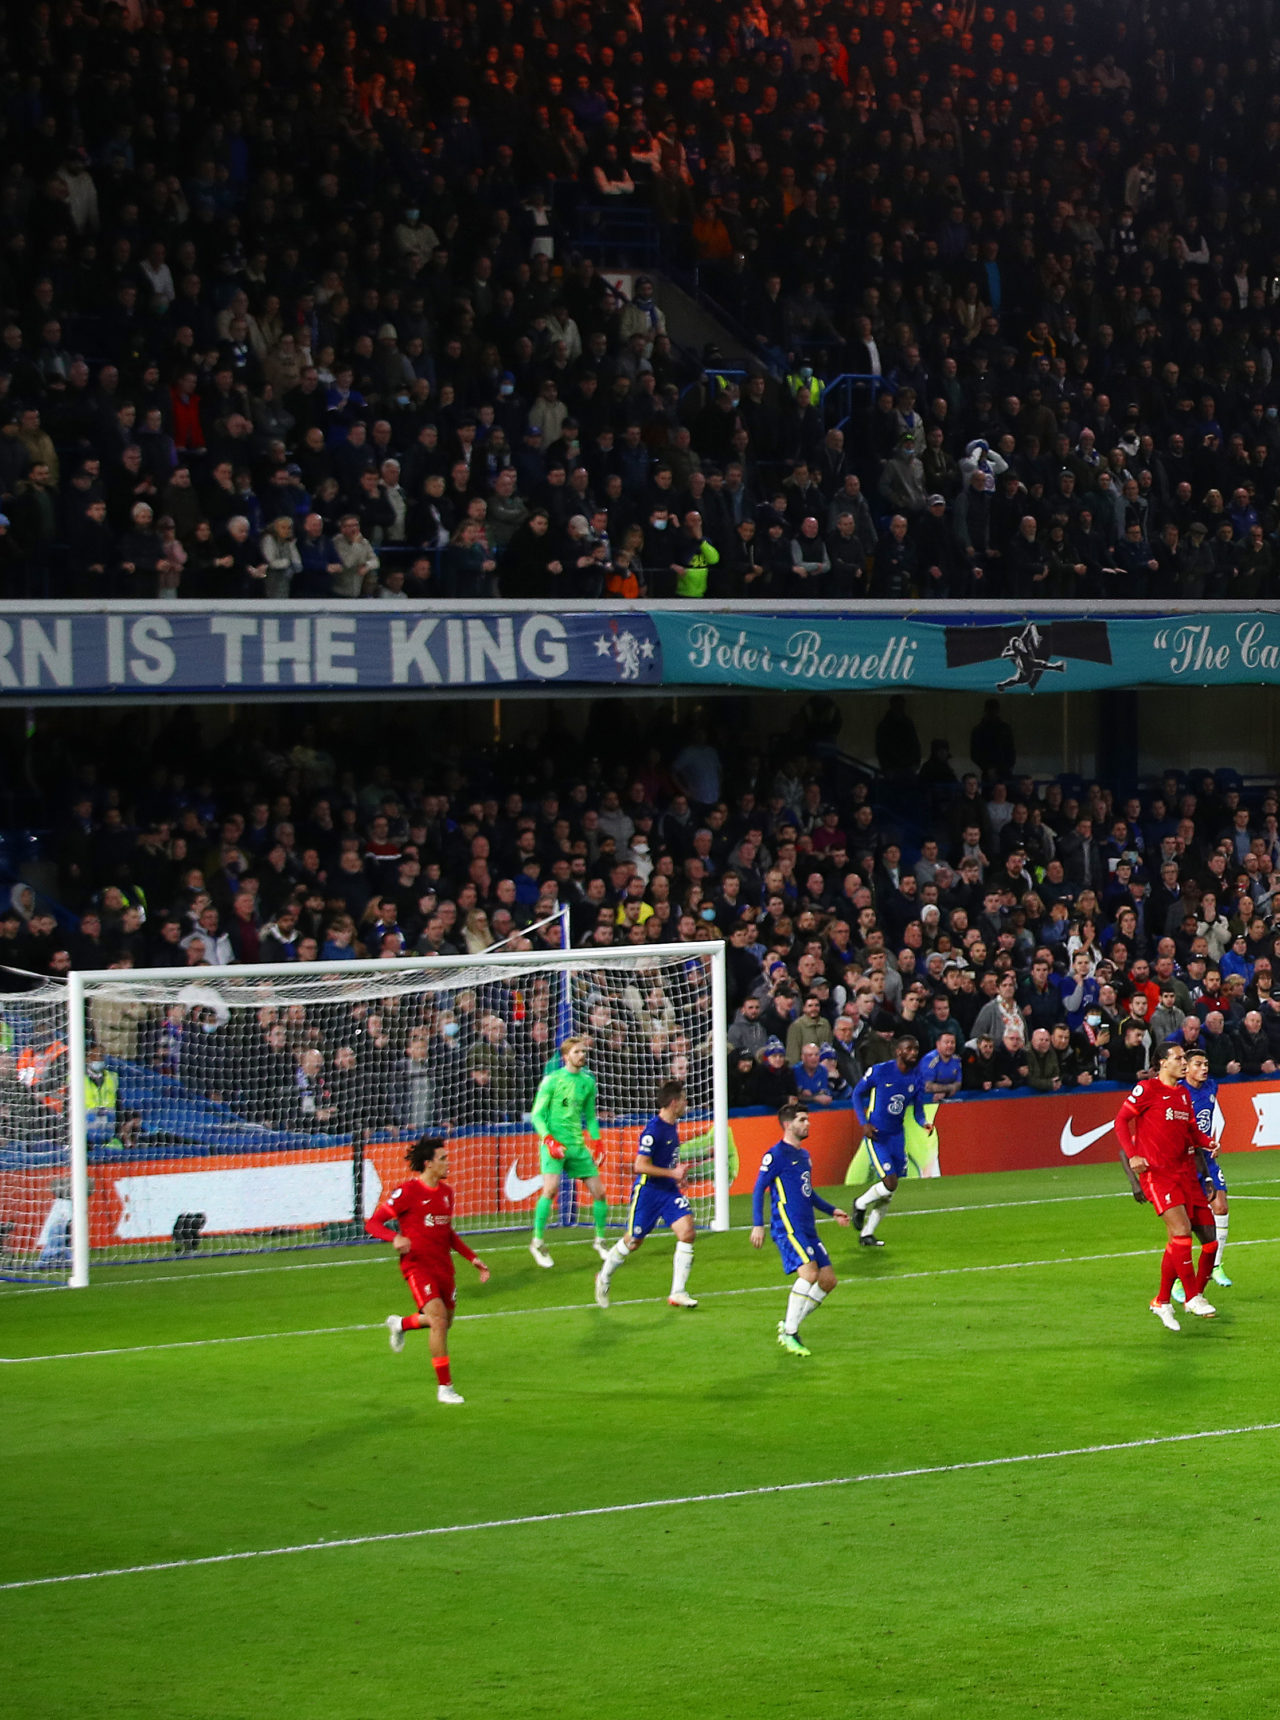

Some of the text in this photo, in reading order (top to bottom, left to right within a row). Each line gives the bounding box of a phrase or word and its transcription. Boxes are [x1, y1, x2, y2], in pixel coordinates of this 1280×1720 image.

[107, 616, 177, 685] IS
[211, 616, 358, 684] THE
[390, 615, 569, 684] KING
[688, 623, 918, 680] Peter Bonetti
